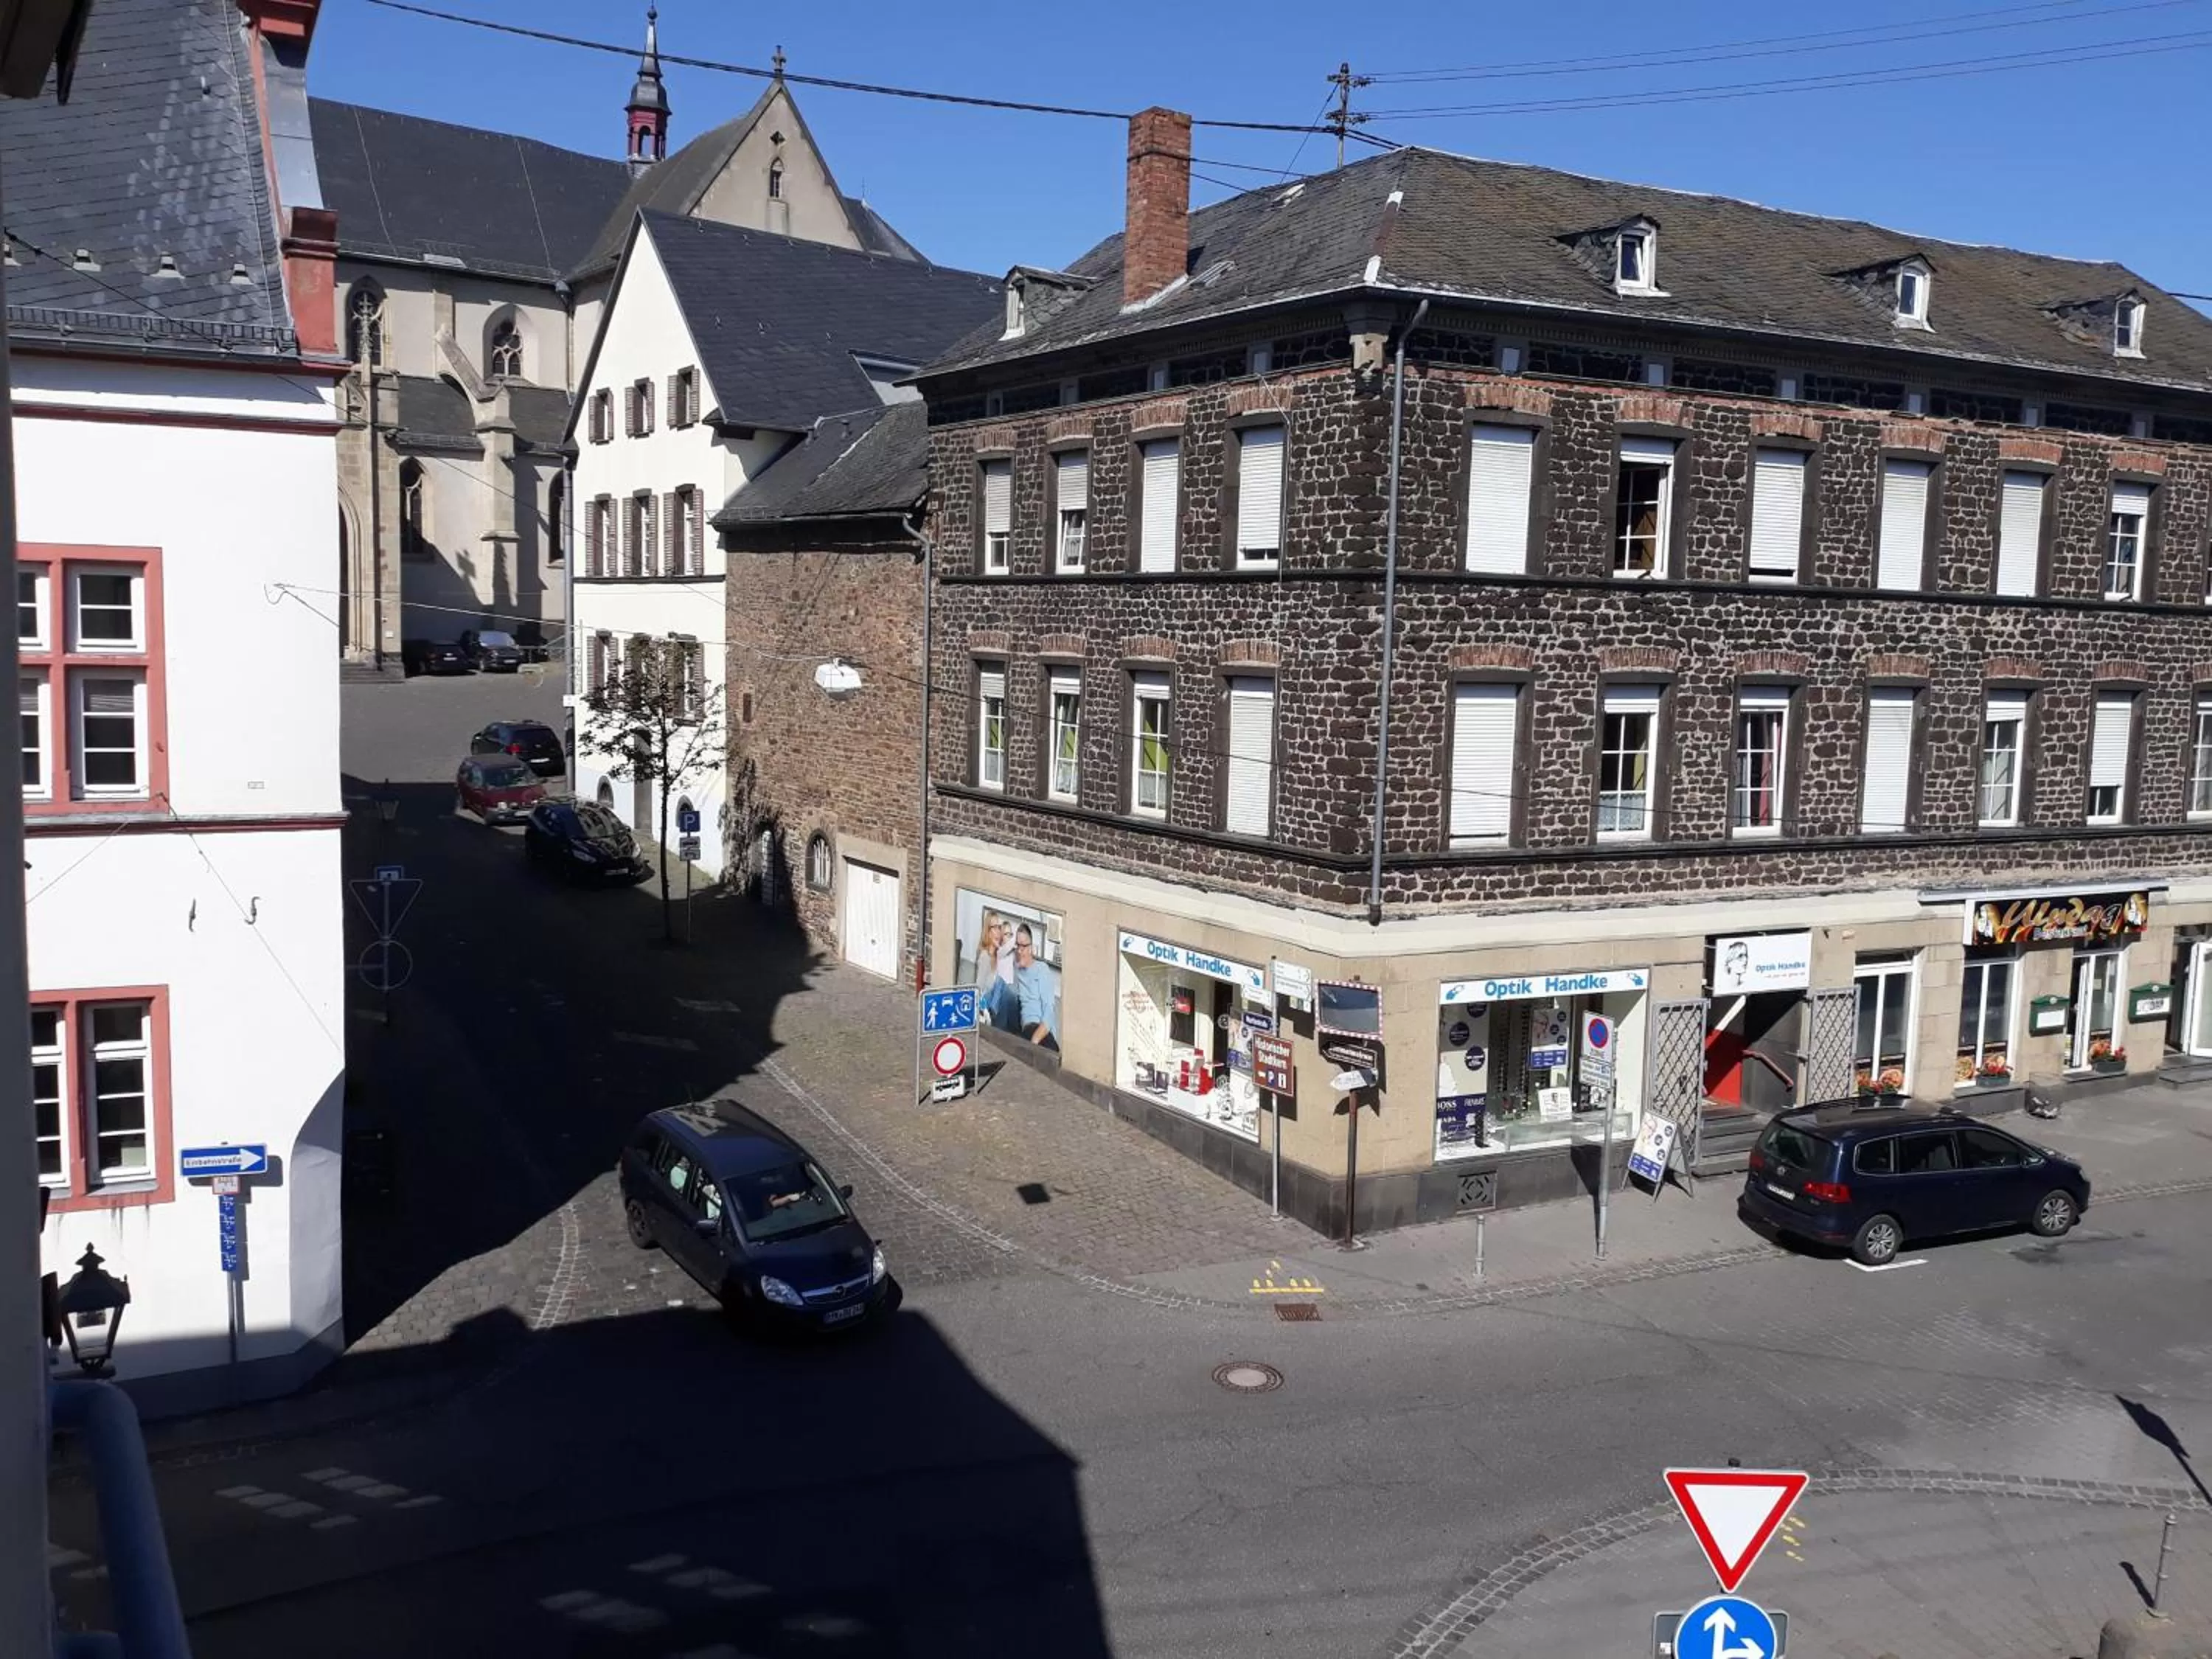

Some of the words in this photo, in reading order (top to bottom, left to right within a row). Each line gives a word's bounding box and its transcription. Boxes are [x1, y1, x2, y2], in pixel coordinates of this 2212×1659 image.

[684, 813, 695, 830] P
[1147, 941, 1178, 961] Optik
[1186, 952, 1231, 977] Handke
[1484, 979, 1532, 998] Optik
[1545, 974, 1608, 992] Handke
